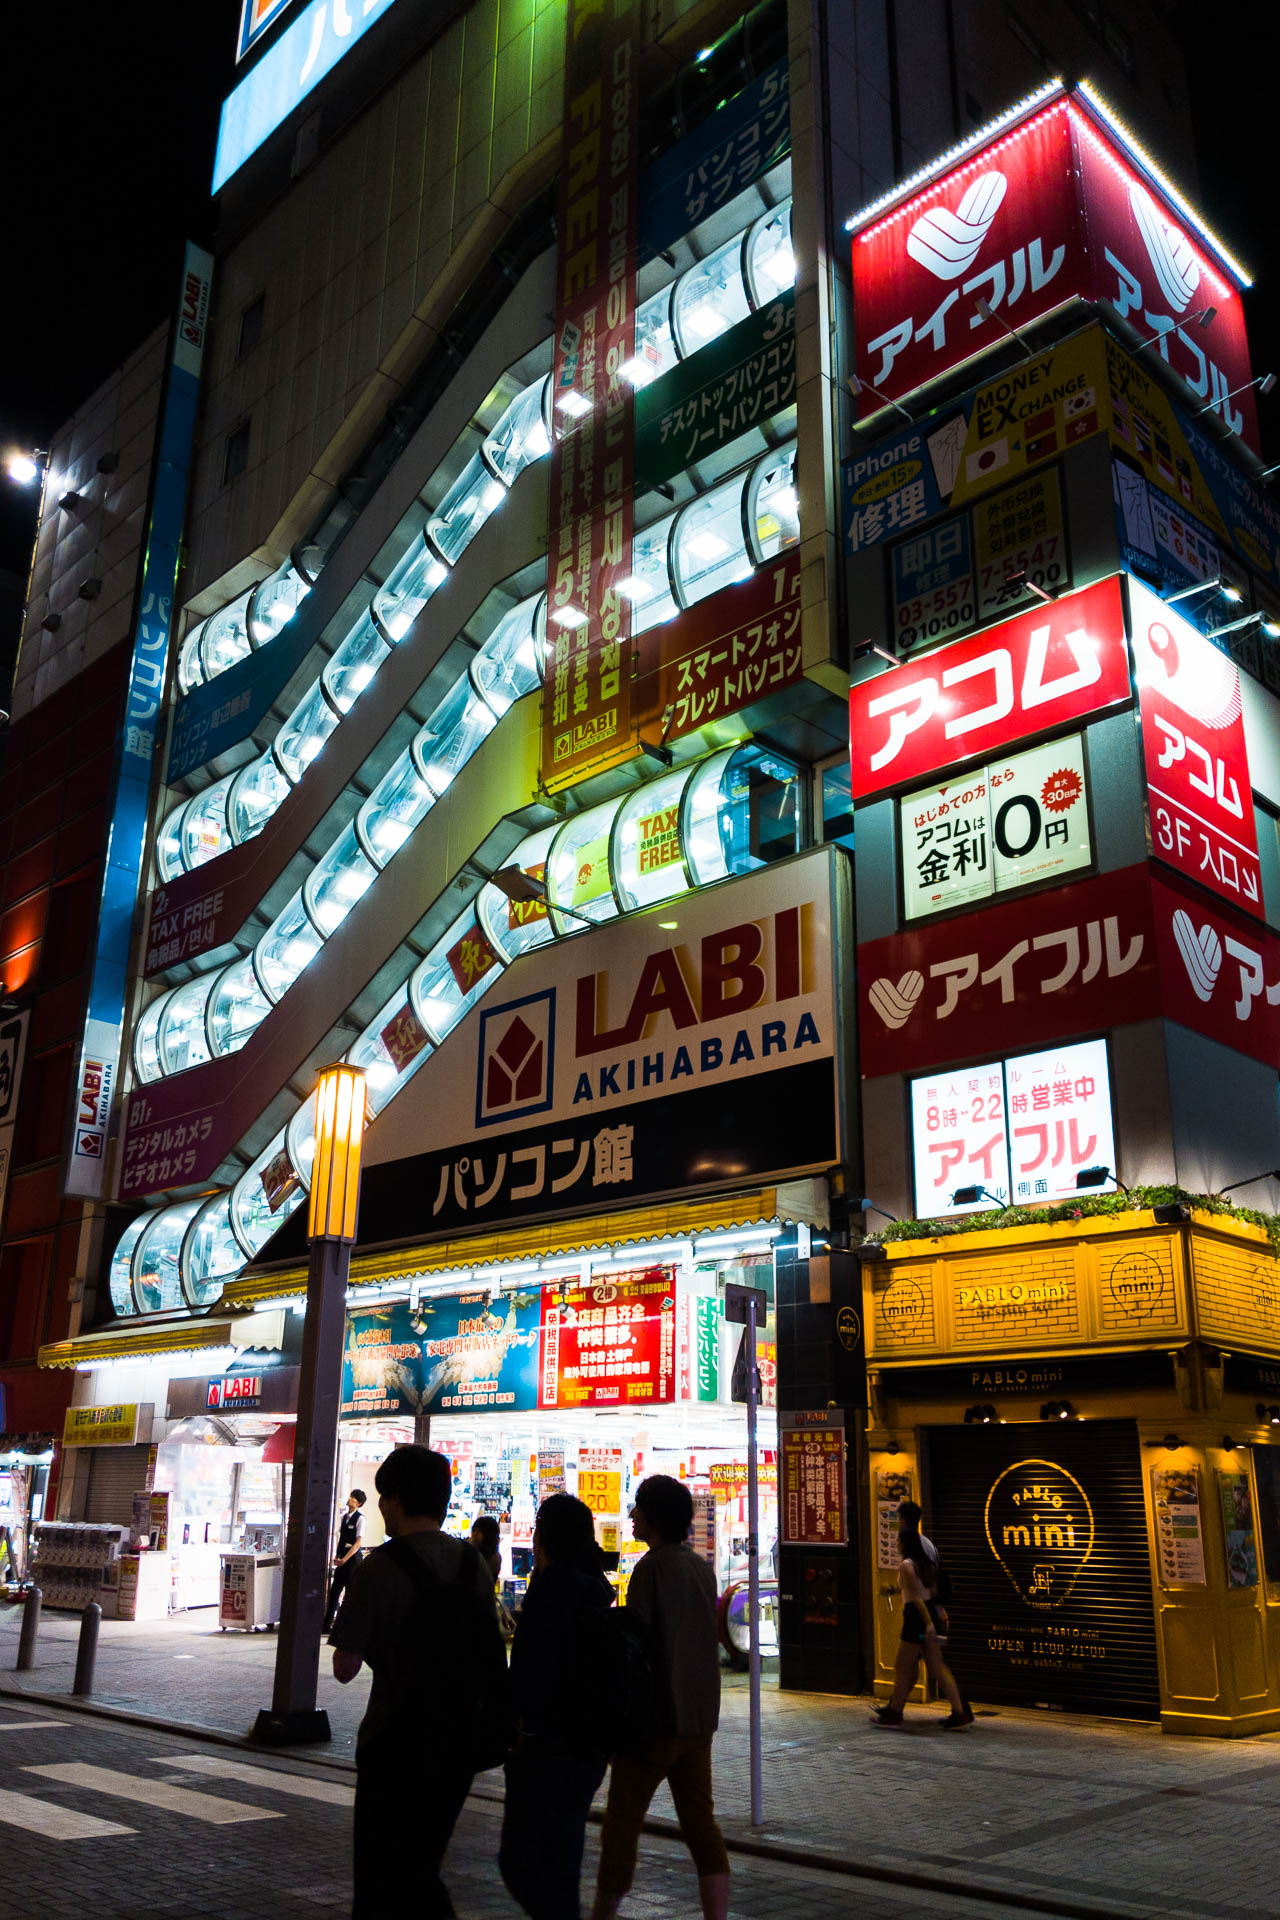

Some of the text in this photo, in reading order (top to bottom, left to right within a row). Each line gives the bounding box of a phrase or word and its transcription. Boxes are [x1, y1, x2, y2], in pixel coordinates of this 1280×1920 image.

[684, 101, 789, 197] パソコン
[564, 79, 602, 306] FREE
[183, 271, 201, 321] LABI
[867, 237, 1066, 388] アイフル
[762, 303, 795, 341] 3F
[1103, 246, 1244, 437] アイフル
[977, 358, 1055, 413] MONEY
[1105, 338, 1153, 388] MONEY
[660, 339, 796, 445] デスクトップパソコン
[685, 372, 796, 460] ノートパソコン
[977, 374, 1087, 440] EXCHANGE
[847, 436, 921, 487] iPhone
[847, 478, 928, 553] 修理
[901, 522, 963, 578] 即日
[772, 567, 801, 604] 1F
[897, 576, 973, 628] 03-557
[915, 563, 951, 593] 修理
[676, 607, 802, 692] スマートフォン
[124, 591, 172, 761] パソコン館
[661, 645, 802, 735] タブレットパソコン
[868, 624, 1103, 772] アコム
[573, 707, 617, 745] LABI
[1053, 778, 1069, 789] 最大
[1154, 713, 1244, 820] アコム
[914, 768, 1016, 829] はじめての方なら
[1045, 788, 1078, 805] 30日間
[639, 808, 679, 840] TAX
[916, 812, 986, 851] アコムは
[640, 839, 681, 873] FREE
[916, 832, 988, 889] 金利
[151, 890, 225, 943] TAX FREE
[575, 903, 815, 1059] LABI
[929, 914, 1145, 1020] アイフル
[572, 1011, 822, 1106] AKIHABARA
[79, 1060, 103, 1126] LABI
[98, 1064, 113, 1128] AKIHABARA
[128, 1098, 152, 1128] B1F
[126, 1115, 214, 1163] デジタルカメラ
[927, 1117, 1098, 1188] アイフル
[123, 1149, 197, 1190] ビデオカメラ
[433, 1123, 636, 1217] パソコン館
[552, 1292, 586, 1305] Wecome!
[888, 1299, 917, 1316] mini
[960, 1280, 1066, 1305] PABLO mini
[1118, 1280, 1155, 1295] mini
[223, 1377, 260, 1398] LABI
[972, 1367, 1063, 1386] PABLO mini
[1257, 1367, 1280, 1385] PAB
[1012, 1485, 1062, 1509] PABLO
[515, 1522, 532, 1534] PAY
[1002, 1513, 1076, 1547] mini
[987, 1637, 1025, 1653] OPEN
